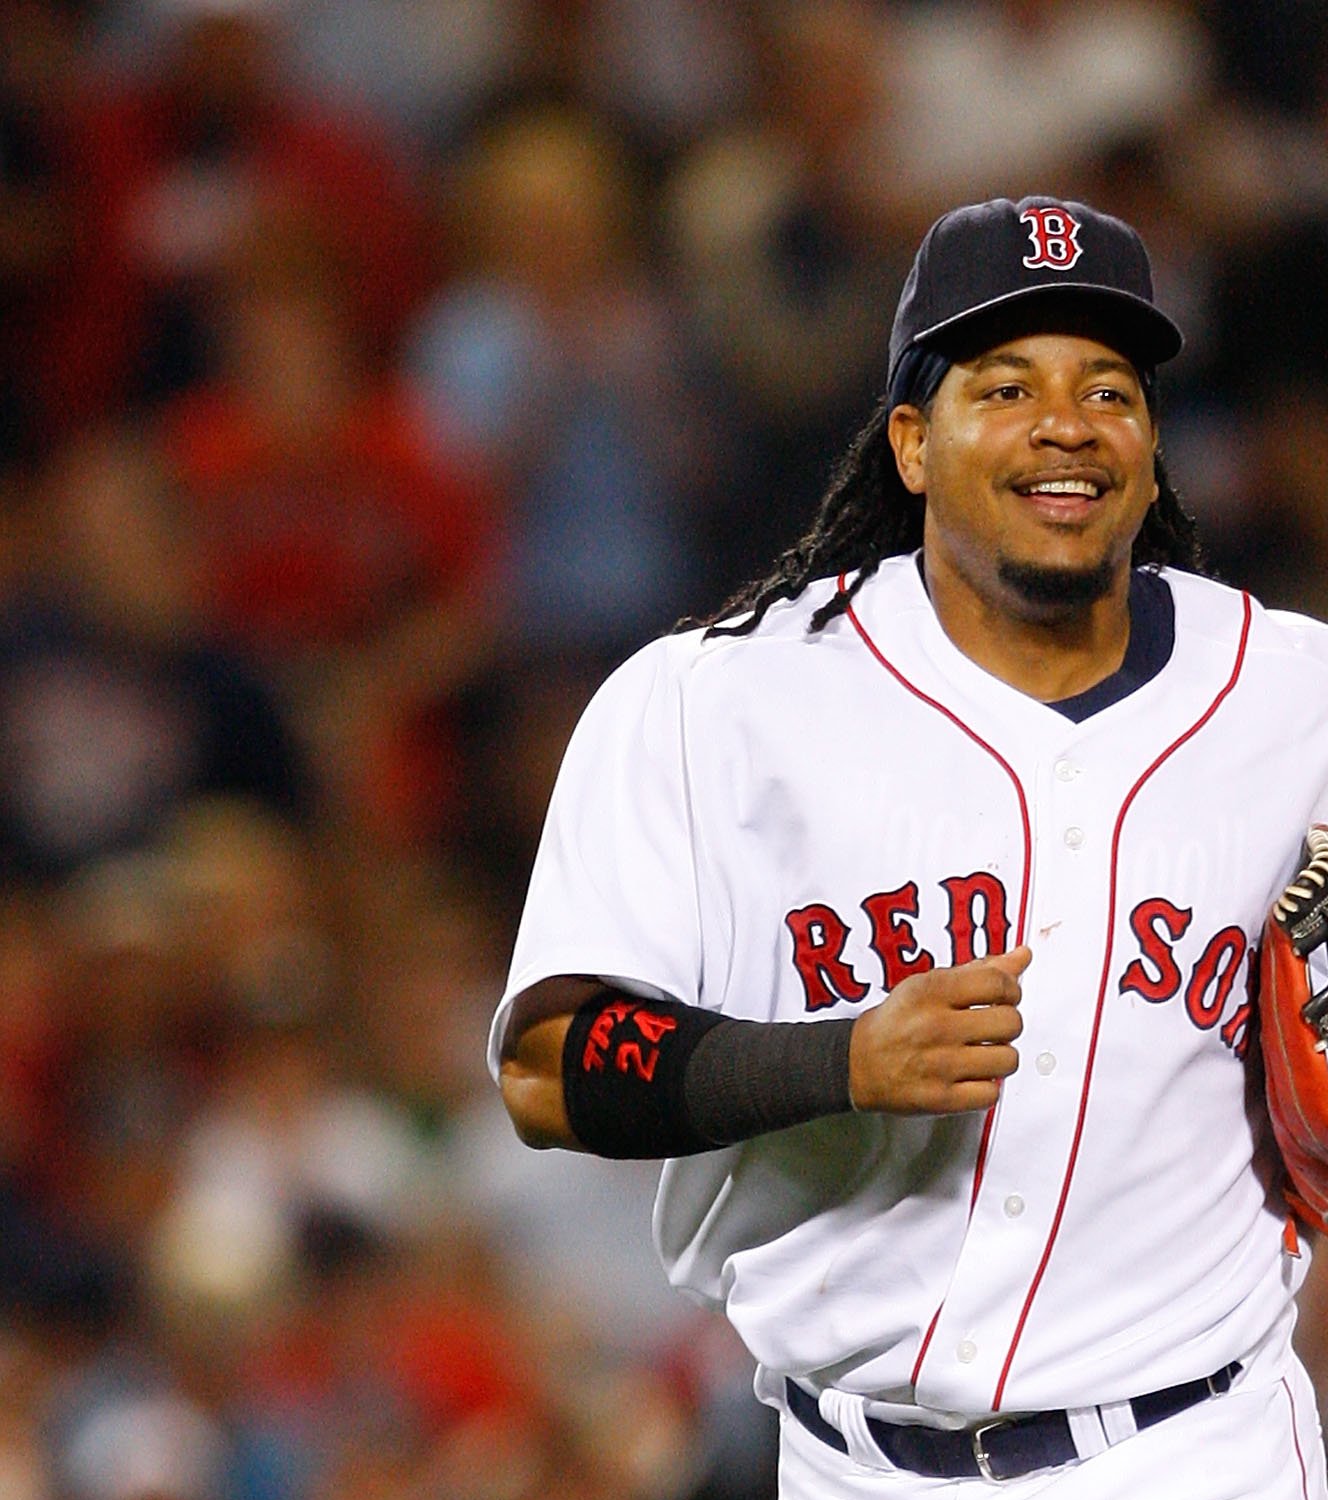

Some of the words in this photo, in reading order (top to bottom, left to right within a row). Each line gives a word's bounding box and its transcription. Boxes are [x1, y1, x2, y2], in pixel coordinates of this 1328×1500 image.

[1020, 207, 1083, 270] B
[785, 871, 1011, 1012] RED
[616, 1008, 677, 1082] 24
